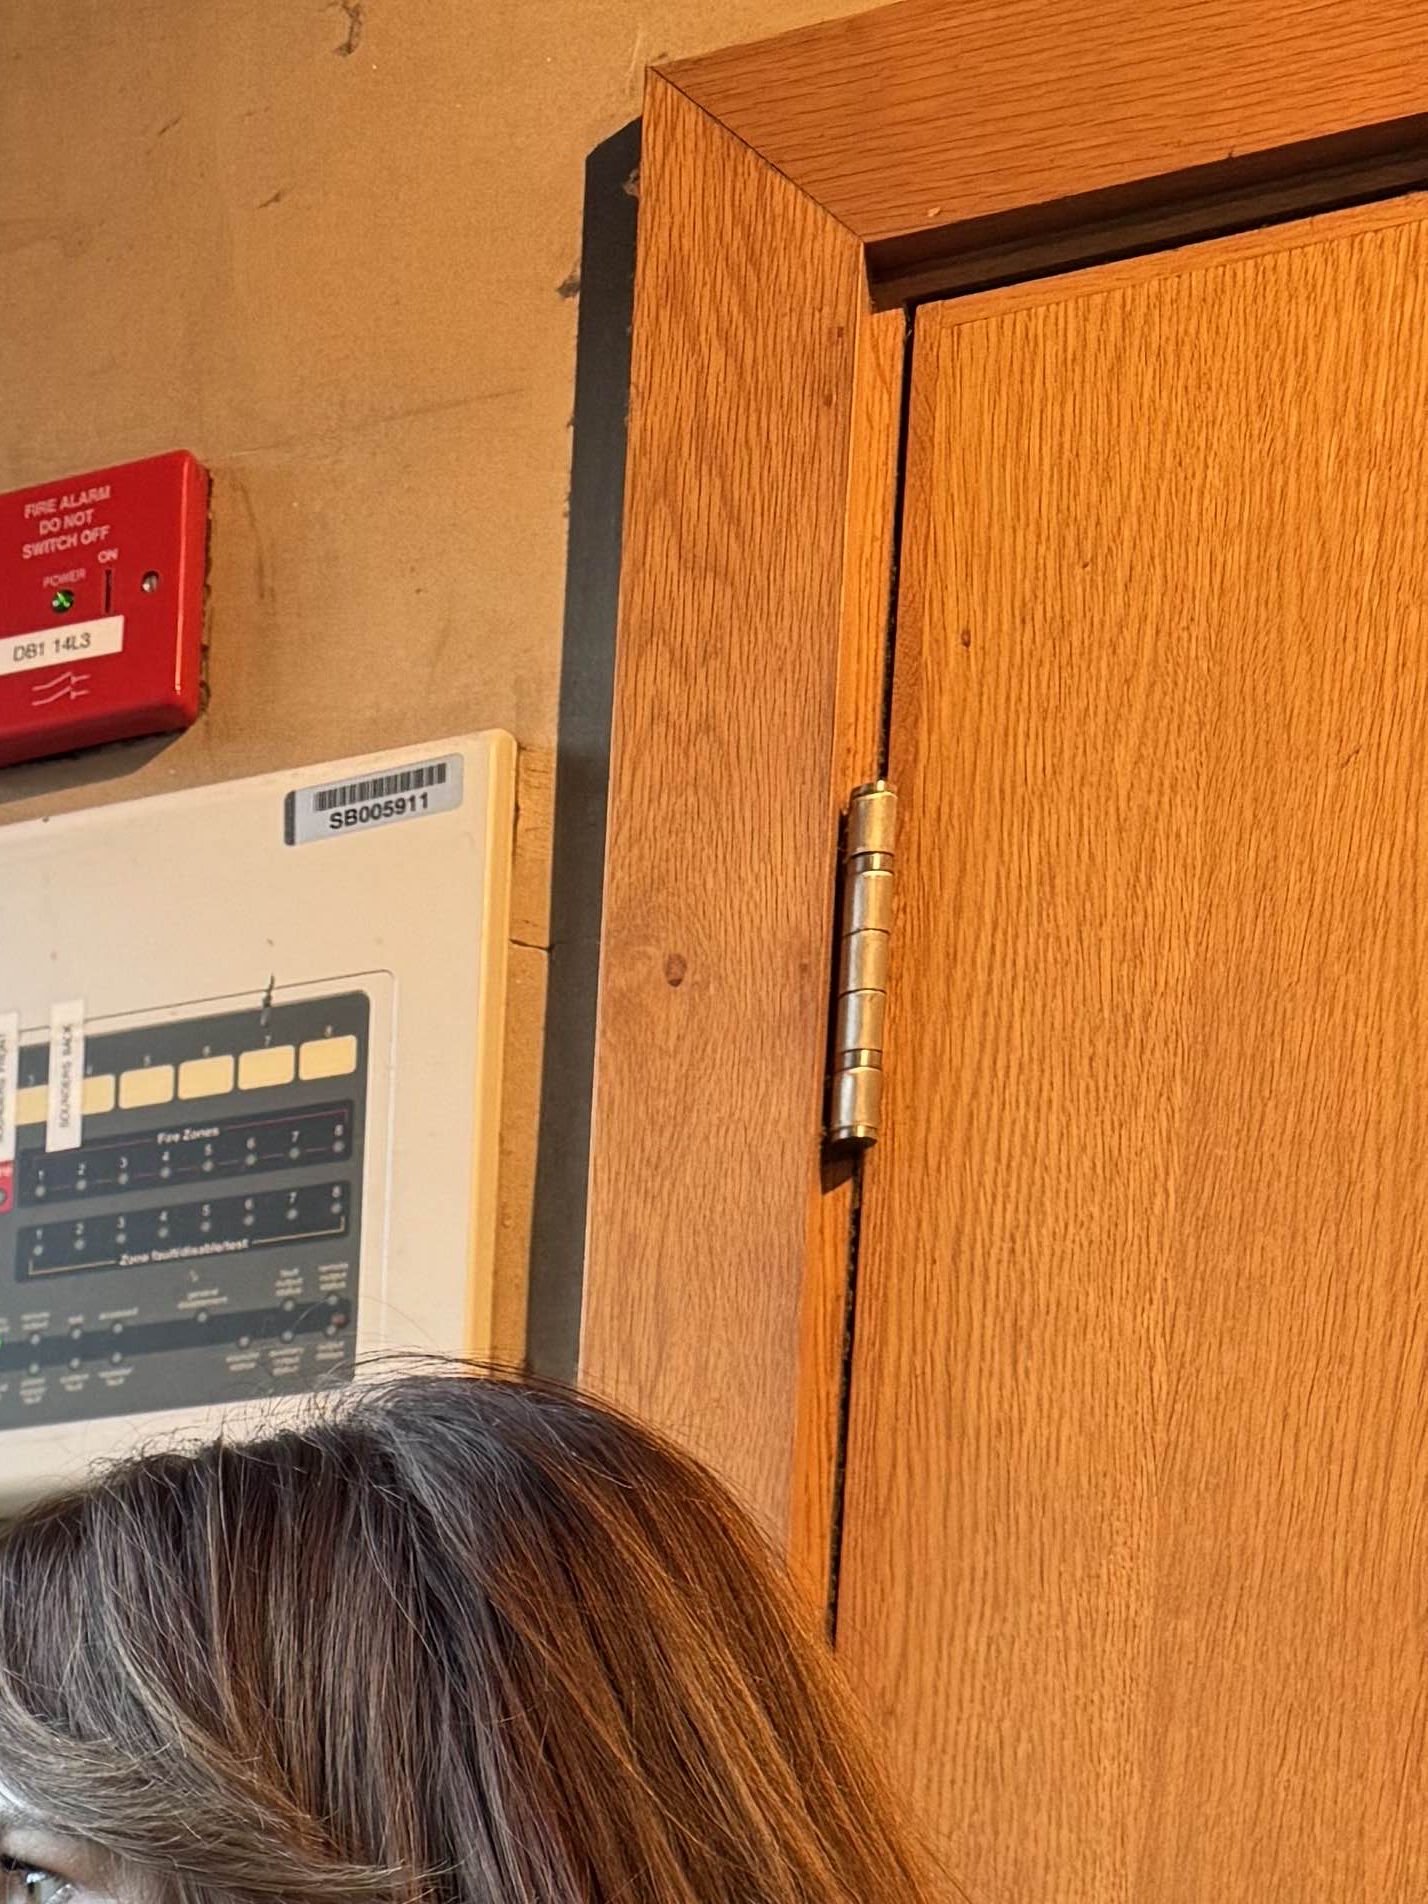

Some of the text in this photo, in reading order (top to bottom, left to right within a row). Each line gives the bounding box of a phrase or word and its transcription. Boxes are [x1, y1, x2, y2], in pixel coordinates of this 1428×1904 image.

[24, 485, 111, 519] FIRE ALARM
[39, 509, 94, 535] DO NOT
[22, 525, 111, 559] SWITCH OFF
[98, 549, 119, 563] ON
[43, 567, 86, 588] POWER
[54, 632, 91, 654] 14L3
[329, 792, 429, 830] SB005911
[58, 1023, 73, 1129] SOUNDERS BACK
[157, 1125, 220, 1145] Fire Zones
[37, 1124, 343, 1181] 1 2 3 4 5 6 7 8
[35, 1186, 340, 1240] 1 2 3 4 5 6 7 8
[119, 1252, 150, 1266] Zone
